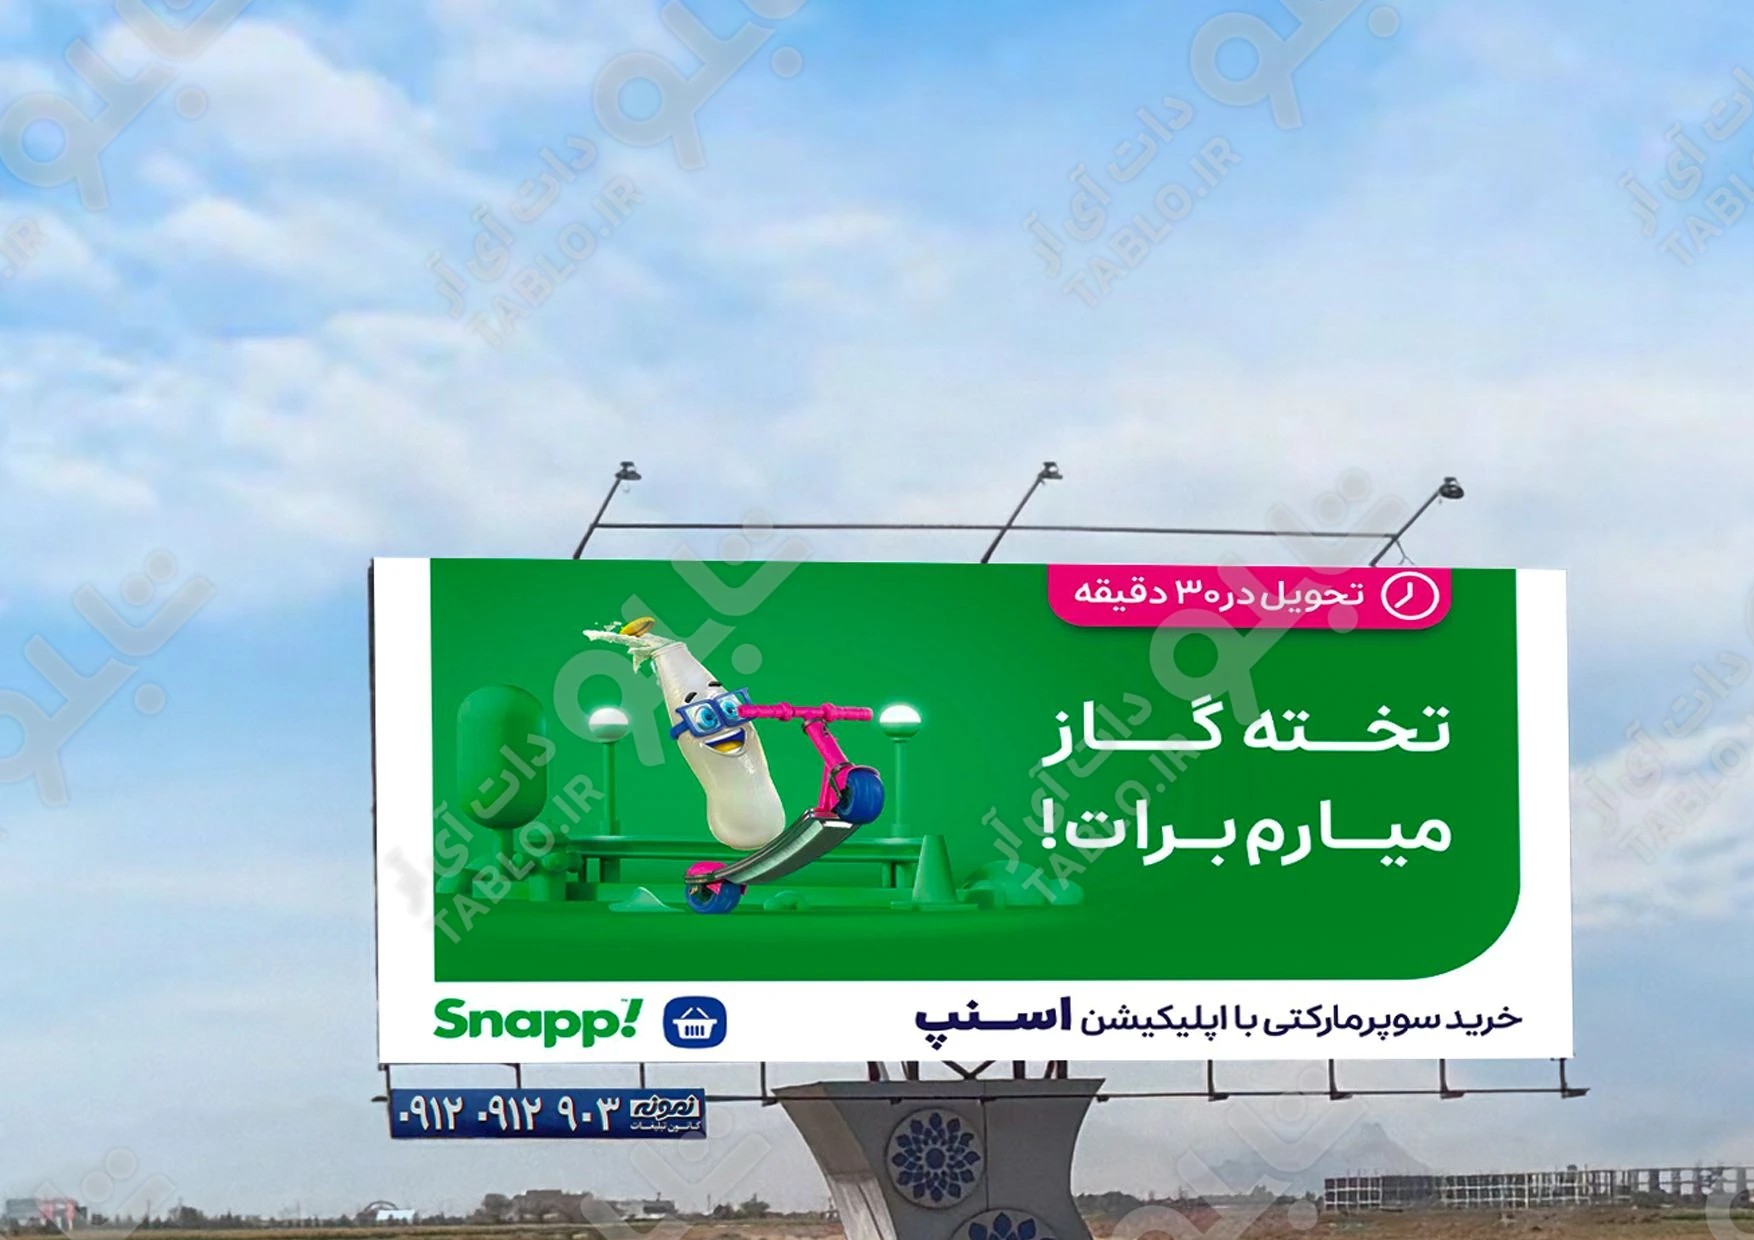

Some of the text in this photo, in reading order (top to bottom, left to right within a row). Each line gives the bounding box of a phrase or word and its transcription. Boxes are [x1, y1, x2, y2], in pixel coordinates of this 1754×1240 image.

[1075, 577, 1167, 611] دقیقه
[1261, 580, 1364, 613] تحویل
[1041, 695, 1450, 767] تخته گاز
[1042, 798, 1451, 867] میارم برات!
[433, 997, 644, 1049] Snapp!
[915, 995, 1523, 1051] خرید سوپرمارکتی با اپلیکیشن اسنپ
[399, 1095, 620, 1131] ۰۹۱۲ ۰۹۱۲ ۹۰۳
[632, 1094, 698, 1122] نمونه
